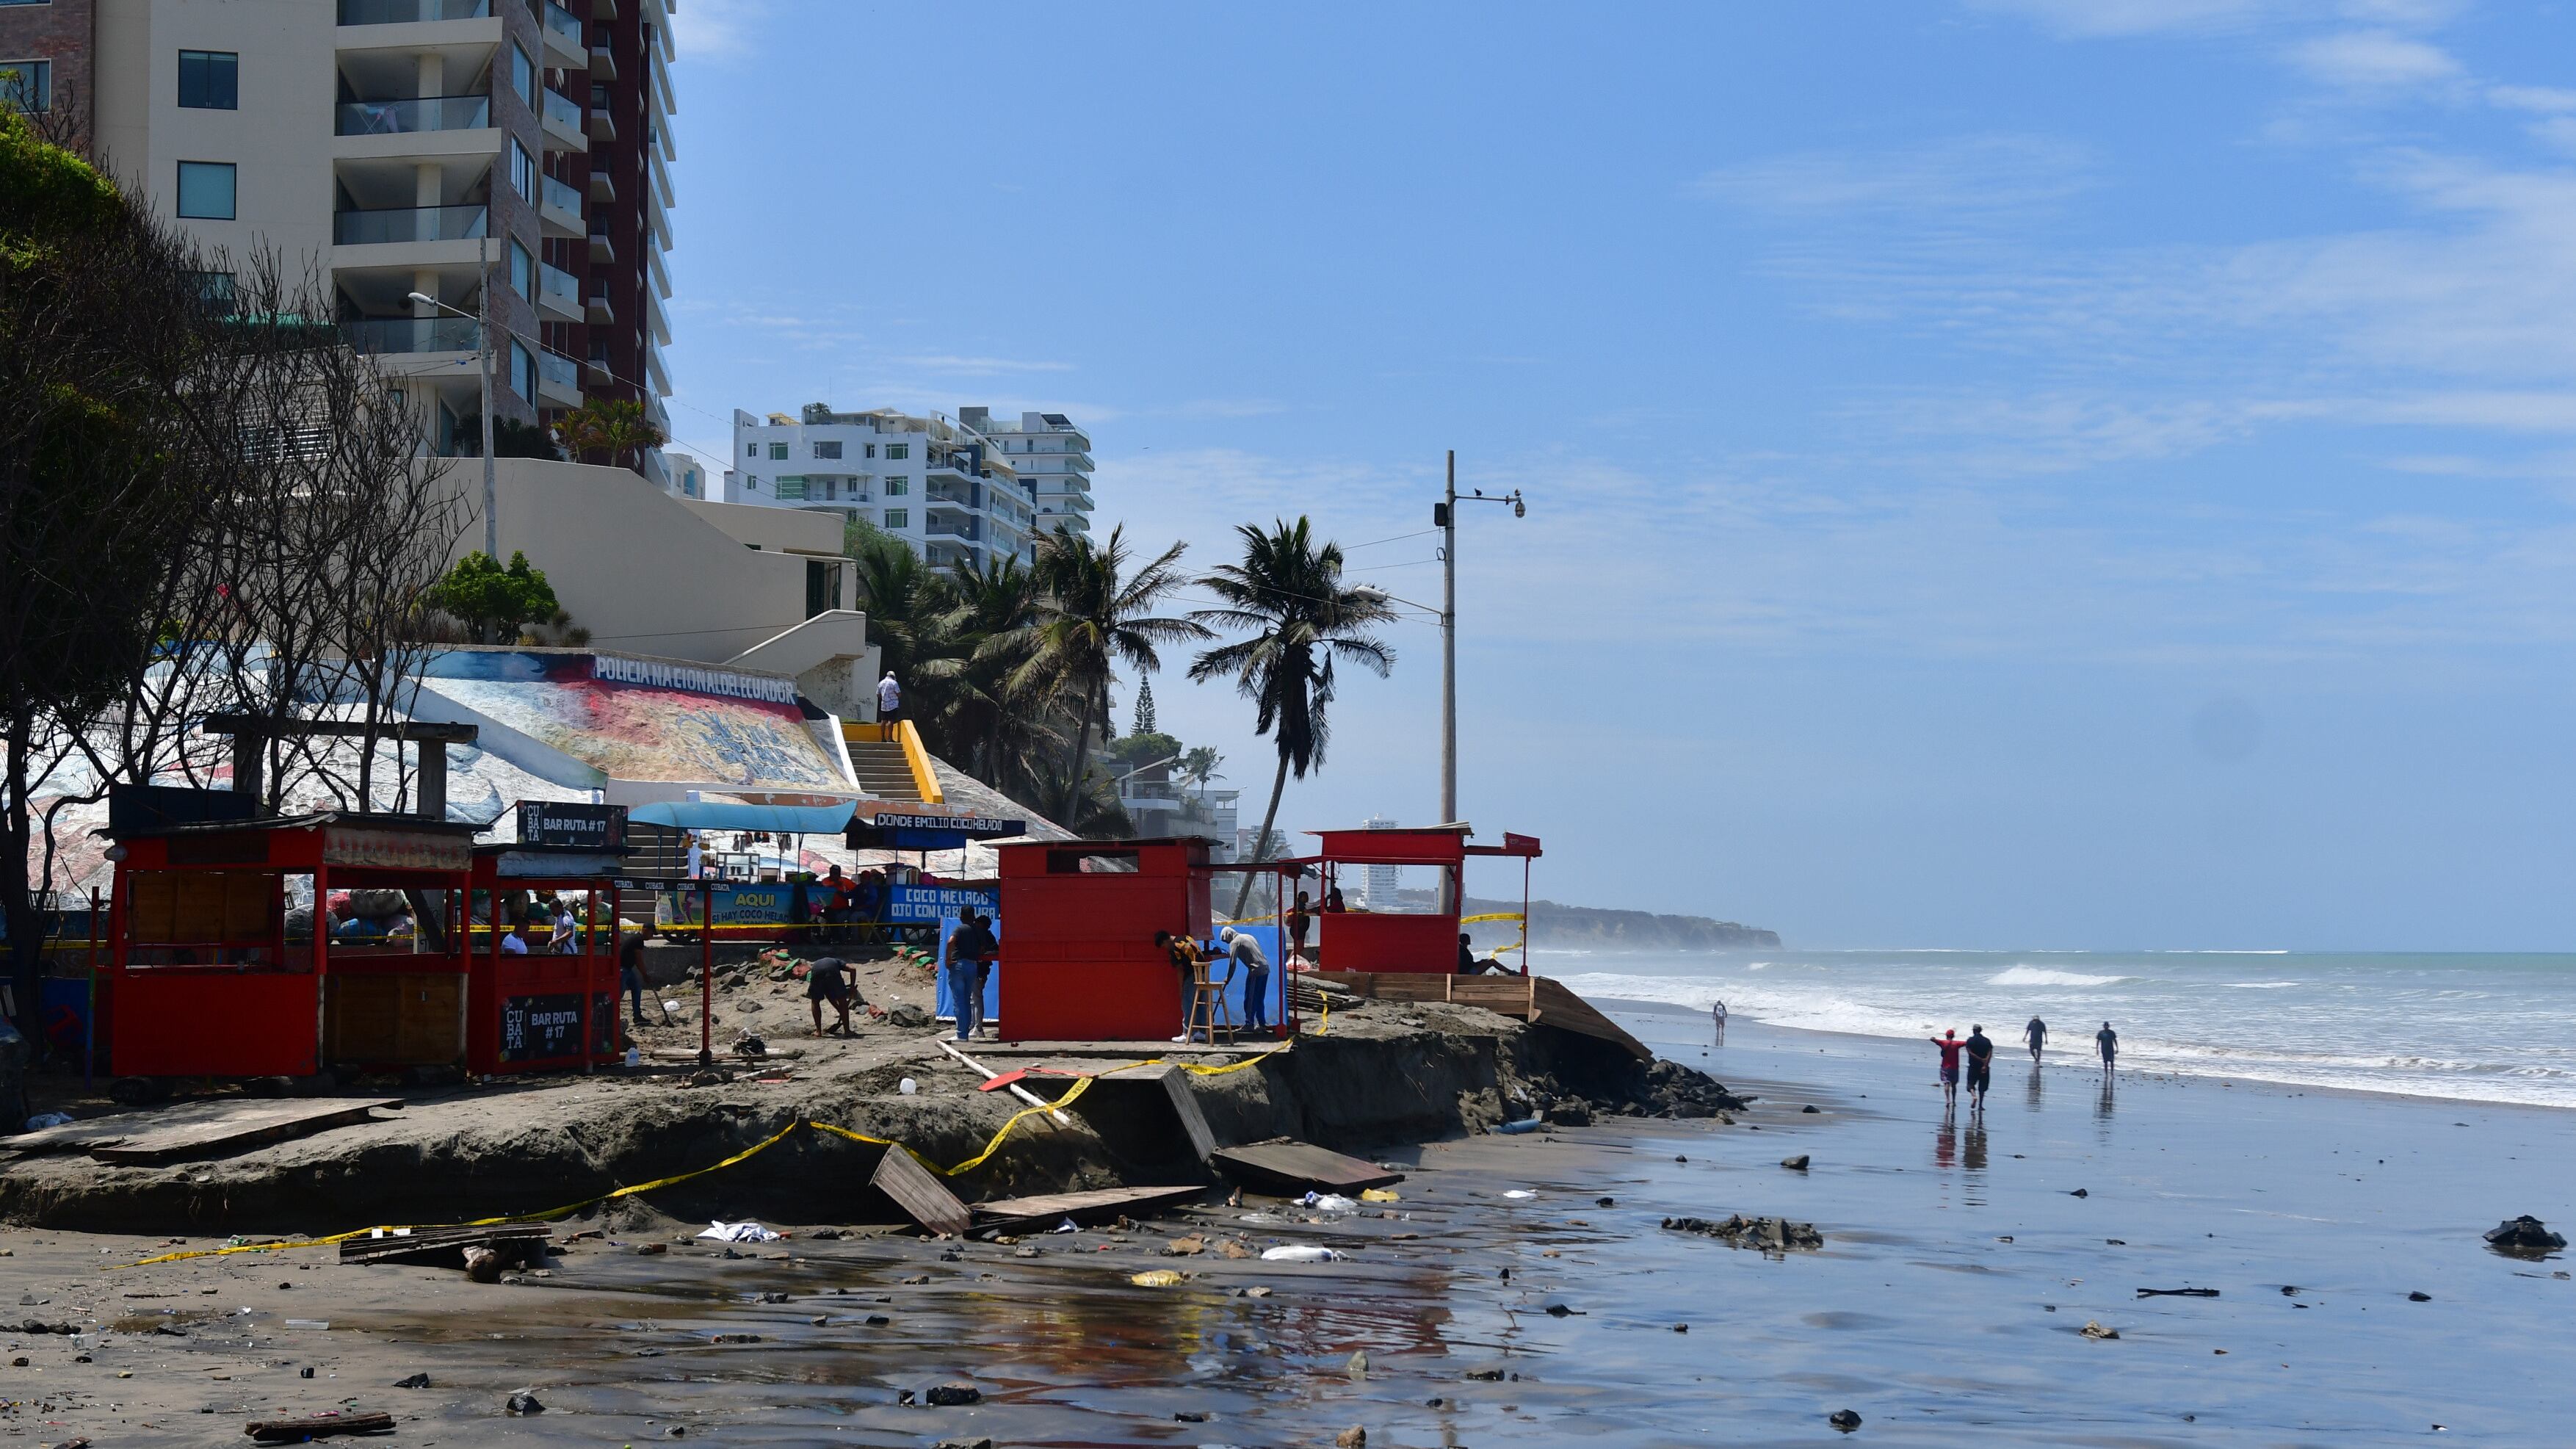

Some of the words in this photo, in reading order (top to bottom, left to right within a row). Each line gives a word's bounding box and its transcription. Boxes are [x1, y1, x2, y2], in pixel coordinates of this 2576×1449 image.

[595, 657, 650, 685] POLICIA
[543, 818, 562, 830] BAR
[564, 819, 587, 831] RUTA
[597, 820, 606, 832] 17
[878, 814, 912, 827] DONDE
[915, 815, 949, 828] EMILIO
[614, 881, 634, 889] CUBATA
[645, 882, 665, 890] CUBATA
[677, 883, 696, 891] CUBATA
[710, 884, 730, 892] CUBATA
[735, 893, 775, 906] AQUI
[905, 889, 936, 903] COCO
[940, 890, 988, 905] HELADO
[721, 911, 737, 922] HAY
[739, 909, 763, 919] COCO
[764, 911, 790, 923] HELAD
[891, 903, 911, 917] OJO
[915, 904, 936, 918] CON
[532, 1013, 551, 1026] BAR
[552, 1011, 577, 1025] RUTA
[555, 1026, 565, 1038] 17
